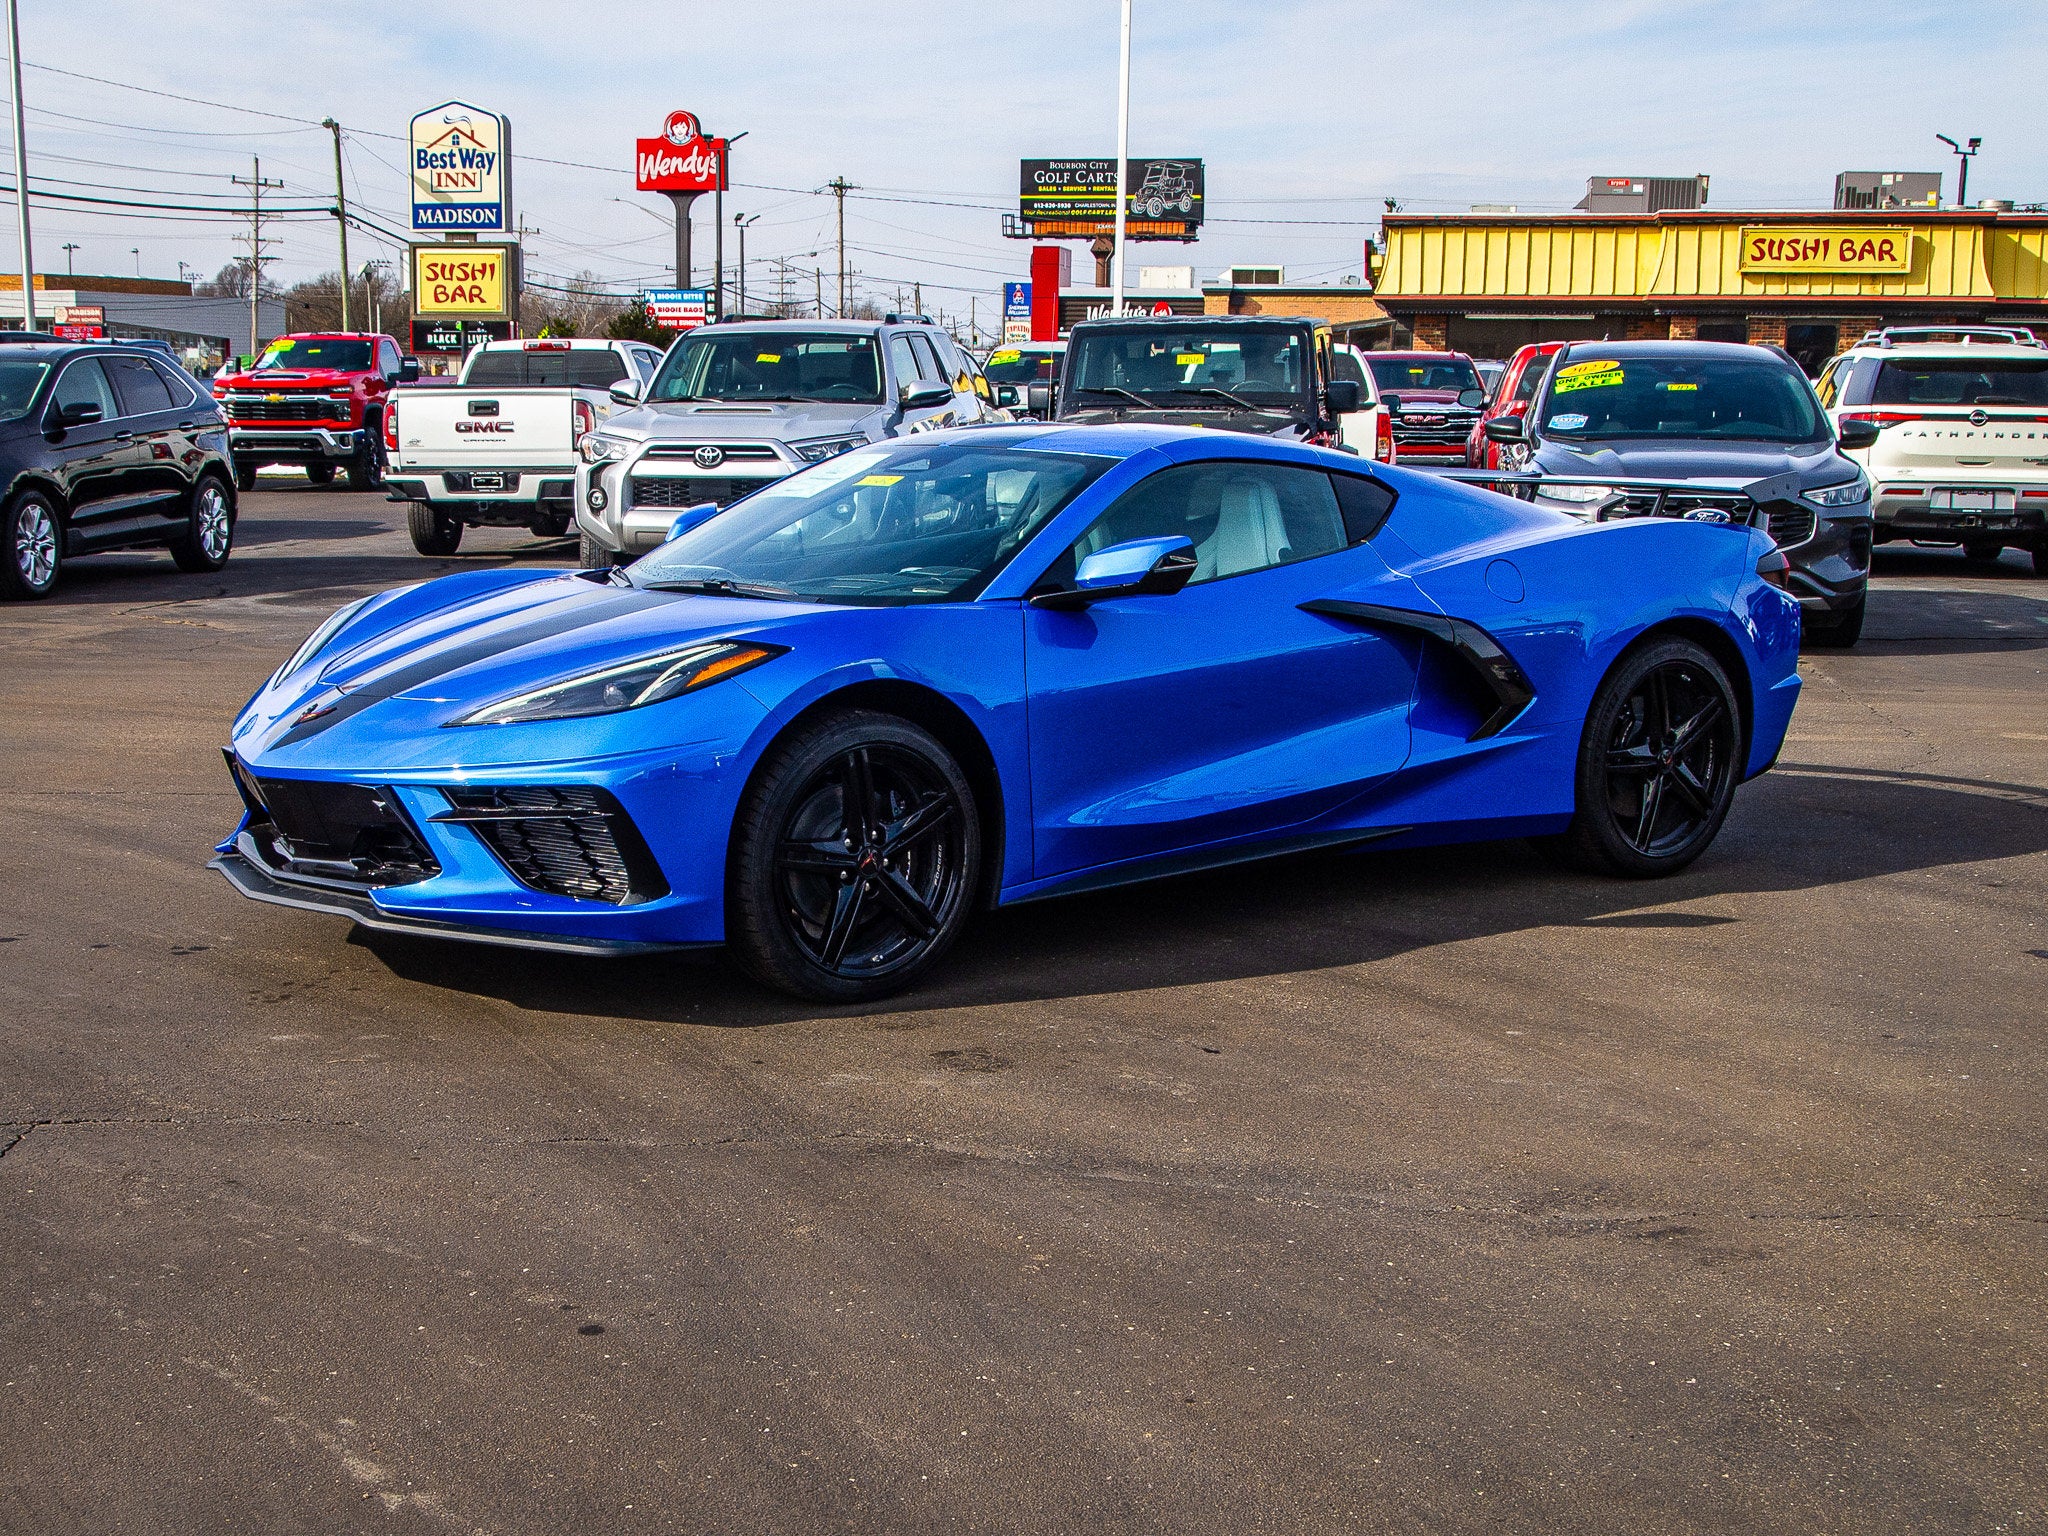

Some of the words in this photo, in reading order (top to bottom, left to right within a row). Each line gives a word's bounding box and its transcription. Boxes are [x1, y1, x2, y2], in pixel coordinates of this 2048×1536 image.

[416, 148, 456, 170] Best
[458, 148, 497, 175] Way
[1049, 161, 1087, 169] BOURBON
[1089, 161, 1109, 169] CITY
[435, 172, 477, 188] INN
[1034, 170, 1070, 184] GOLF
[417, 208, 498, 224] MADISON
[1751, 237, 1830, 262] SUSHI
[1839, 238, 1898, 262] BAR
[425, 263, 496, 282] SUSHI
[433, 284, 487, 304] BAR
[427, 333, 458, 344] BLACK
[467, 333, 494, 344] LIVES
[1558, 377, 1579, 385] ONE
[1584, 372, 1621, 380] OWNER
[455, 421, 515, 433] GMC
[1903, 431, 2048, 440] PATHFINDER
